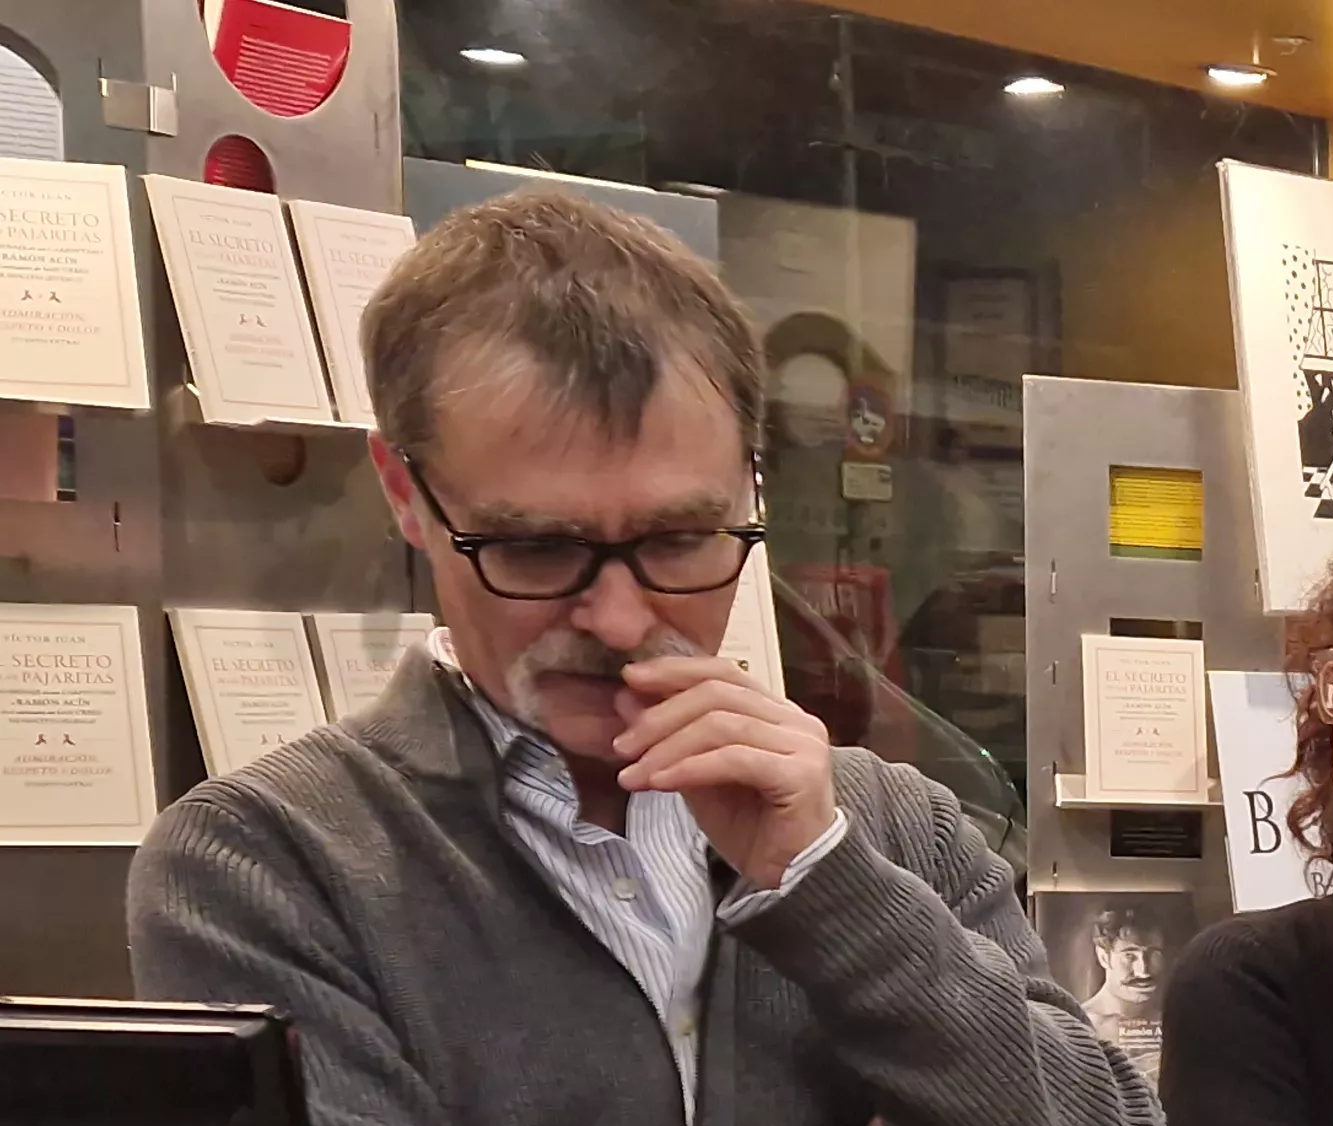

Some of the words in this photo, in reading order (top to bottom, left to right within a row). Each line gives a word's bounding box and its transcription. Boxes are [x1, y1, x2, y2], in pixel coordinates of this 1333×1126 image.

[0, 208, 99, 228] SECRETO
[7, 226, 102, 244] PAJARITAS
[189, 229, 205, 246] EL
[208, 233, 274, 253] SECRETO
[12, 654, 113, 669] SECRETO
[213, 658, 228, 672] EL
[232, 658, 295, 672] SECRETO
[22, 671, 115, 686] PAJARITAS
[1105, 671, 1120, 682] EL
[1124, 671, 1187, 684] SECRETO
[1119, 1026, 1152, 1036] Ramón
